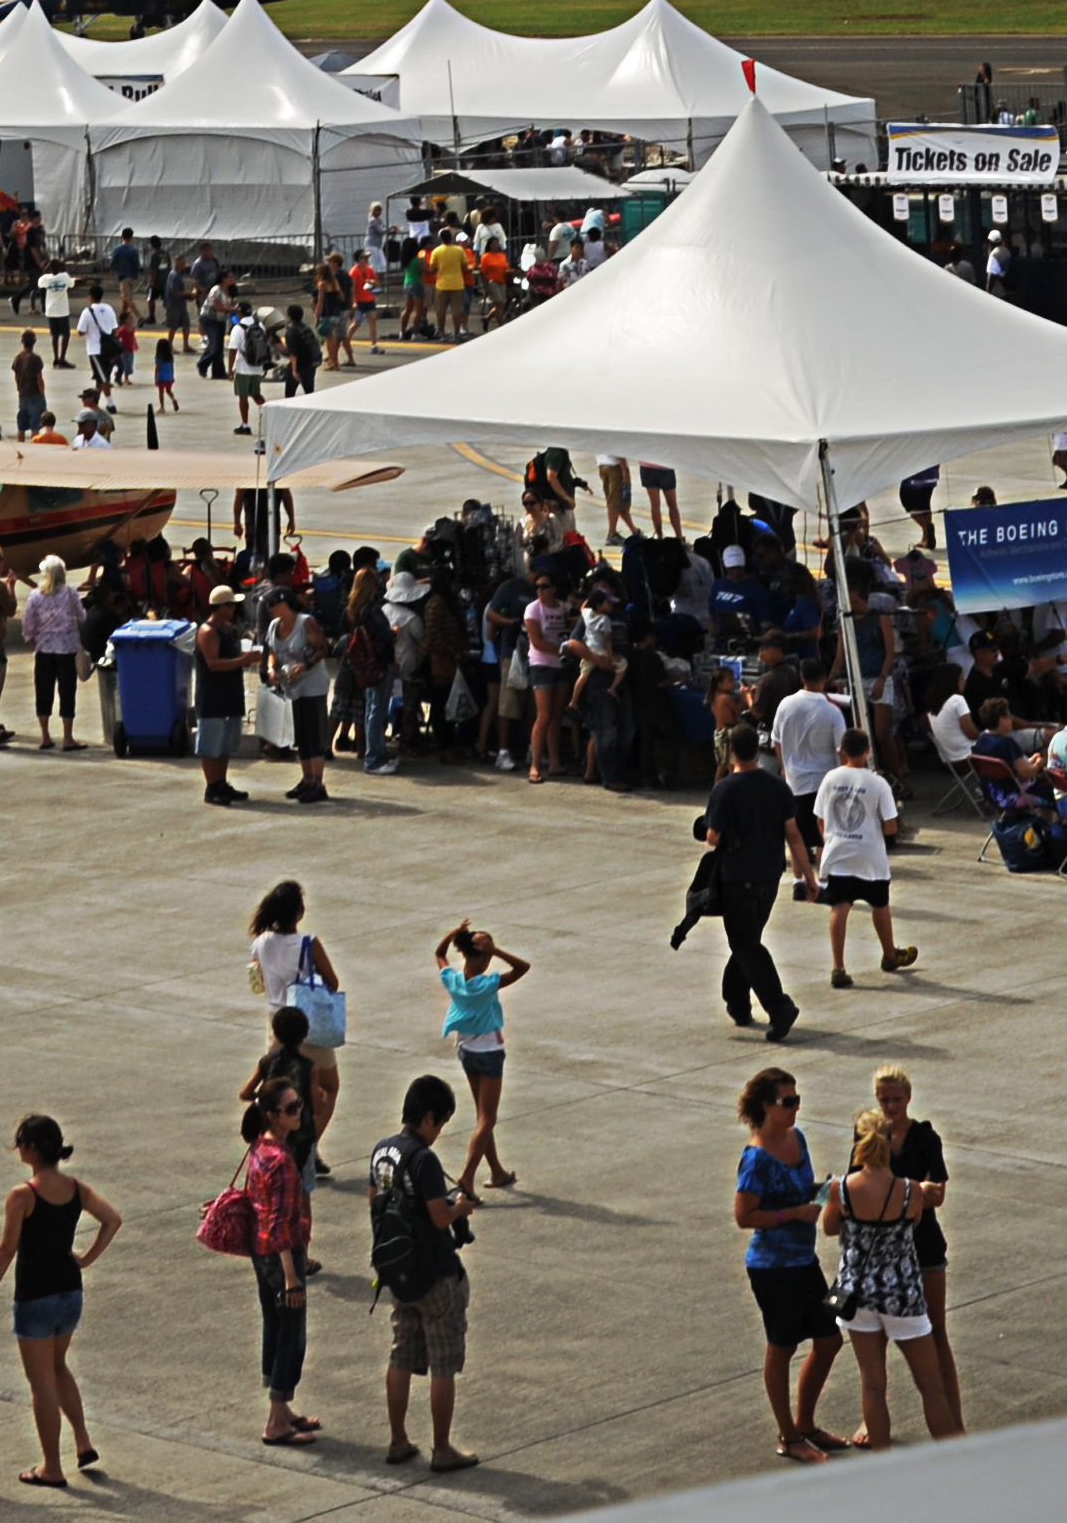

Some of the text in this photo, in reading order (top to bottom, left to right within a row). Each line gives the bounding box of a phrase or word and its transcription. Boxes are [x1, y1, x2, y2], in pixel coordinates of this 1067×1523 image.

[895, 147, 1052, 172] Tickets on Sale
[958, 520, 1058, 546] THE BOEING
